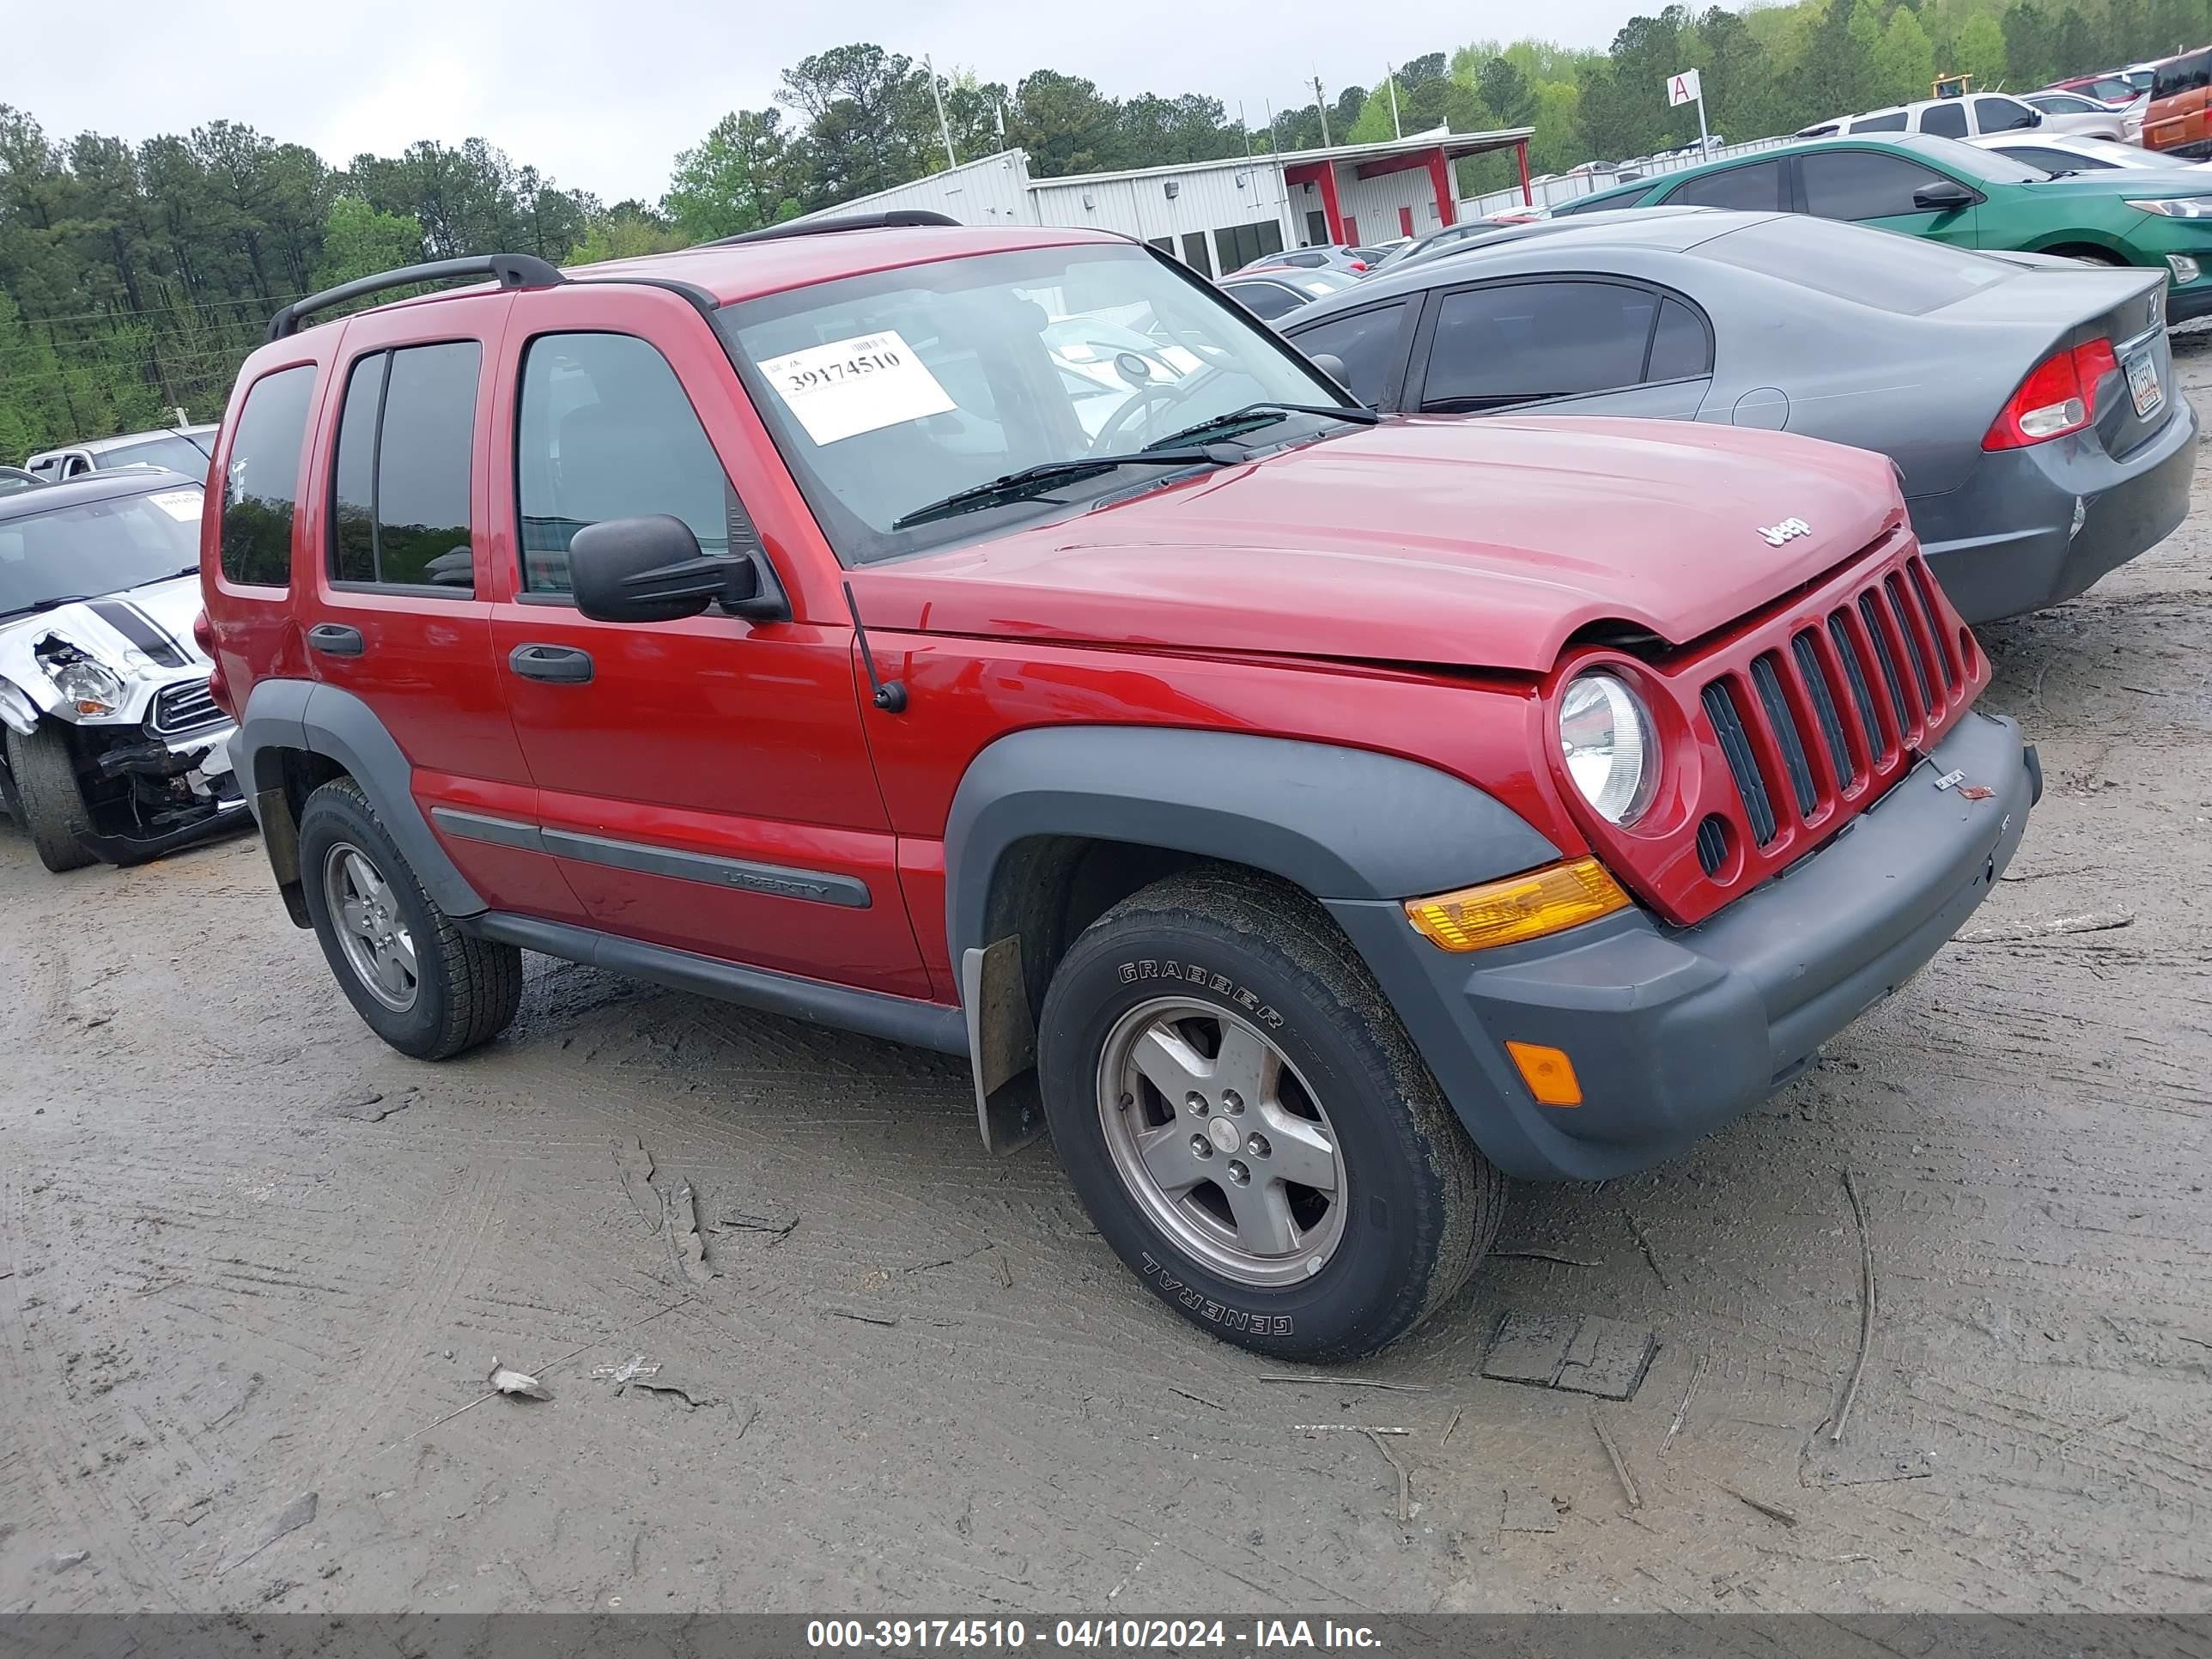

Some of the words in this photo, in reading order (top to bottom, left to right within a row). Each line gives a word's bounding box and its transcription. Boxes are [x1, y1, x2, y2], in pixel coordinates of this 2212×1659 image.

[1674, 76, 1690, 104] A
[788, 351, 901, 391] 39174510
[1756, 517, 1812, 548] Jeep
[722, 871, 829, 895] LIBERTY
[1118, 960, 1284, 1029] GRABBER
[1142, 1251, 1293, 1336] GENERAL
